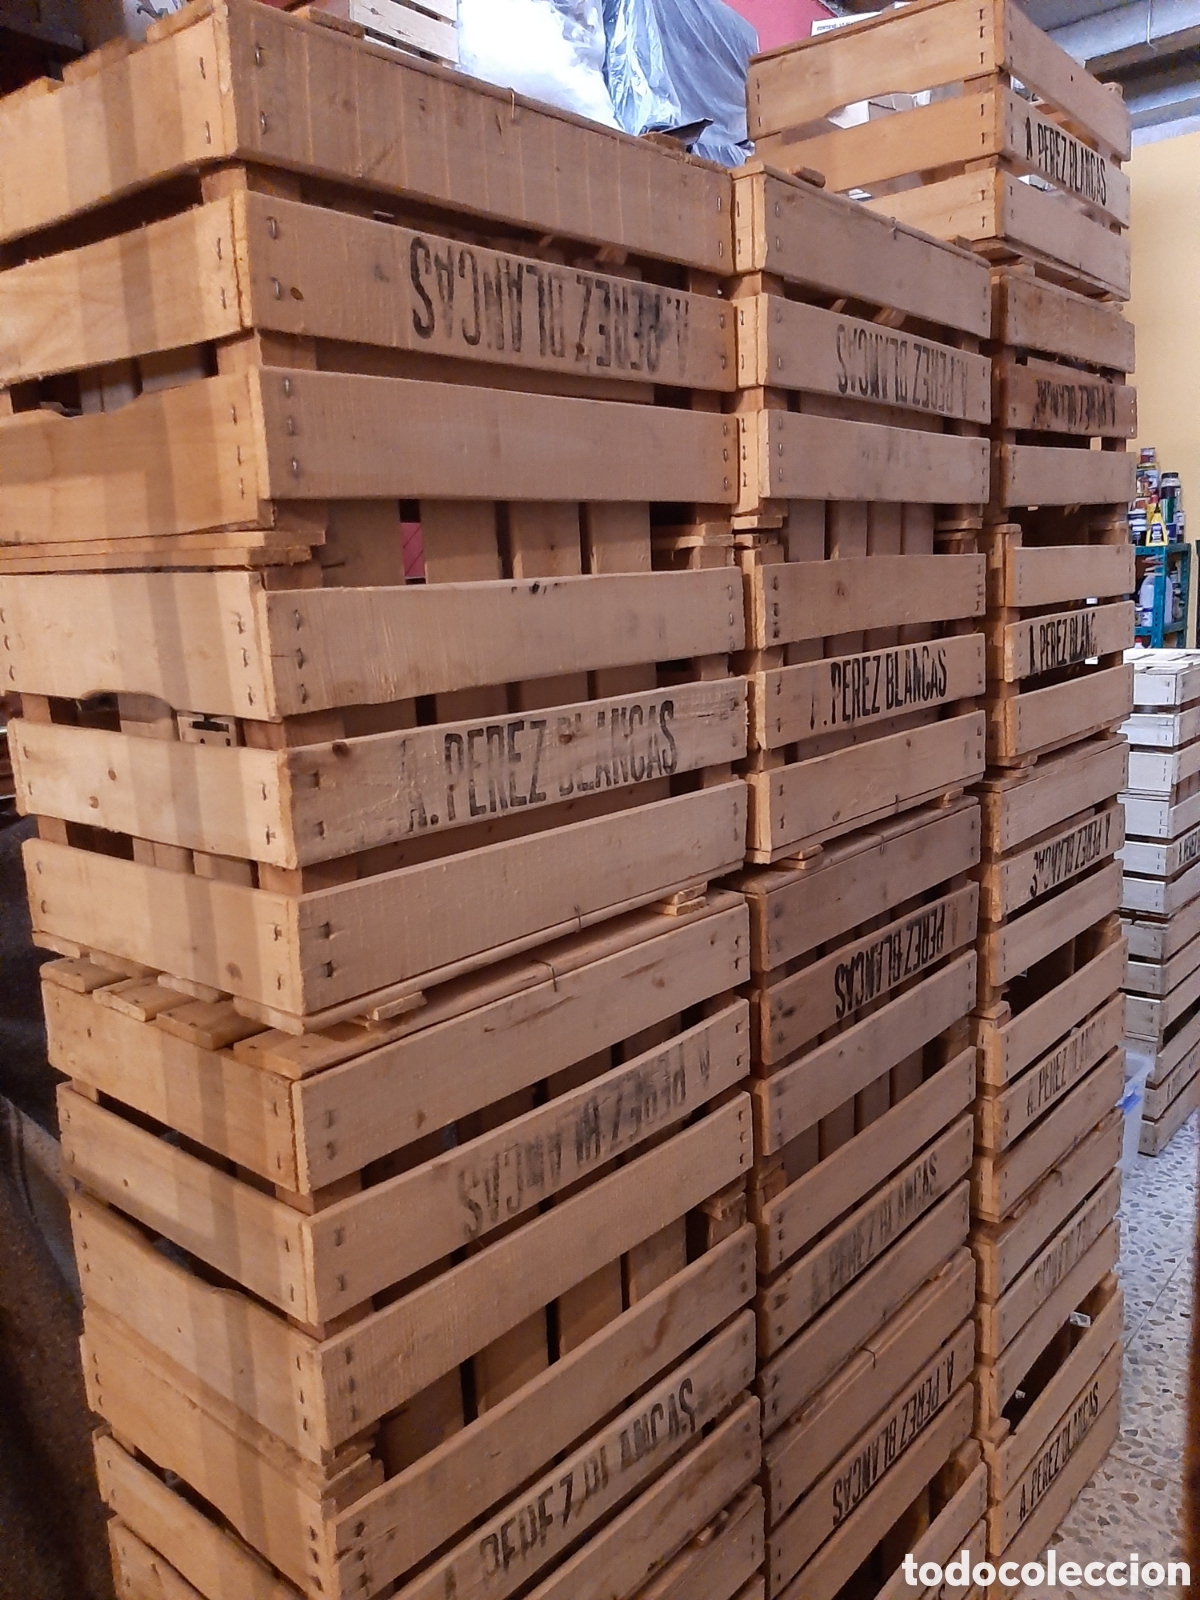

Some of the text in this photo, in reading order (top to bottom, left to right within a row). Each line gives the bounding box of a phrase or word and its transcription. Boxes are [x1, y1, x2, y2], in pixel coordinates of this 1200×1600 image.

[1037, 122, 1067, 185] PEREZ
[1069, 140, 1107, 206] BLANCAS
[831, 655, 881, 724] PEREZ
[885, 645, 947, 710] BLANCAS
[1040, 618, 1068, 671] PEREZ
[444, 719, 547, 821] PEREZ
[834, 928, 902, 1019] BLANCAS
[904, 903, 946, 975] PEREZ
[901, 1366, 940, 1447] PEREZ
[832, 1415, 897, 1527] BLANCAS
[1030, 1436, 1061, 1507] PEREZ
